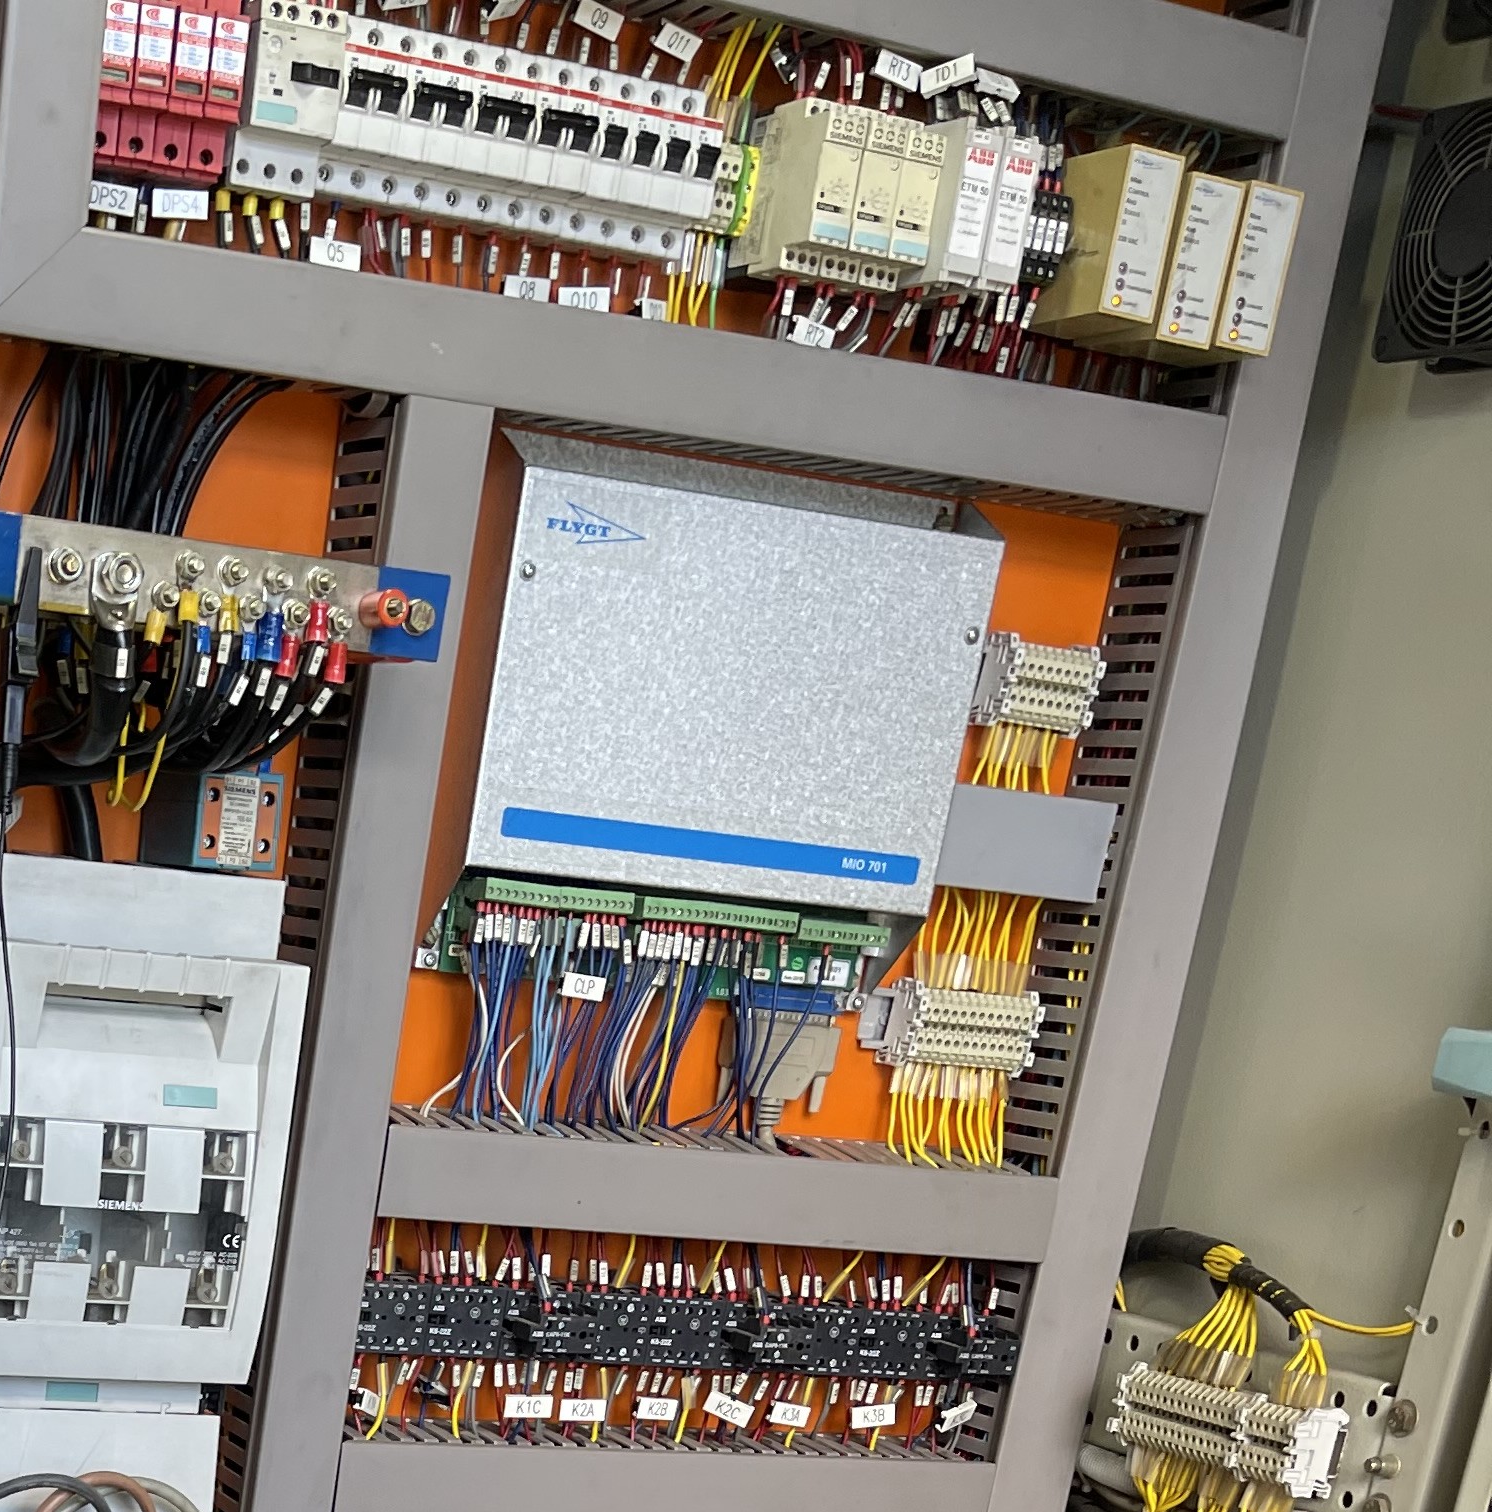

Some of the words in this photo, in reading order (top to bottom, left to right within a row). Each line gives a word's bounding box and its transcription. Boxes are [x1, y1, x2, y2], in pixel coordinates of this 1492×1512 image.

[591, 8, 608, 30] Q9
[667, 30, 689, 53] Q11
[888, 57, 912, 81] RT3
[935, 63, 958, 84] TD1
[967, 147, 995, 167] ABB
[1006, 155, 1033, 176] ABB
[162, 191, 199, 213] DPS4
[327, 243, 345, 263] Q5
[547, 516, 611, 538] FLYGT
[841, 857, 865, 871] MIO
[868, 860, 887, 874] 701
[574, 976, 595, 995] CLP
[98, 1199, 145, 1212] SIEMENS
[516, 1400, 541, 1416] K1C
[571, 1403, 595, 1417] K2A
[648, 1401, 667, 1416] K2B
[715, 1399, 740, 1420] K2C
[783, 1407, 800, 1423] K3A
[862, 1407, 885, 1423] K3B
